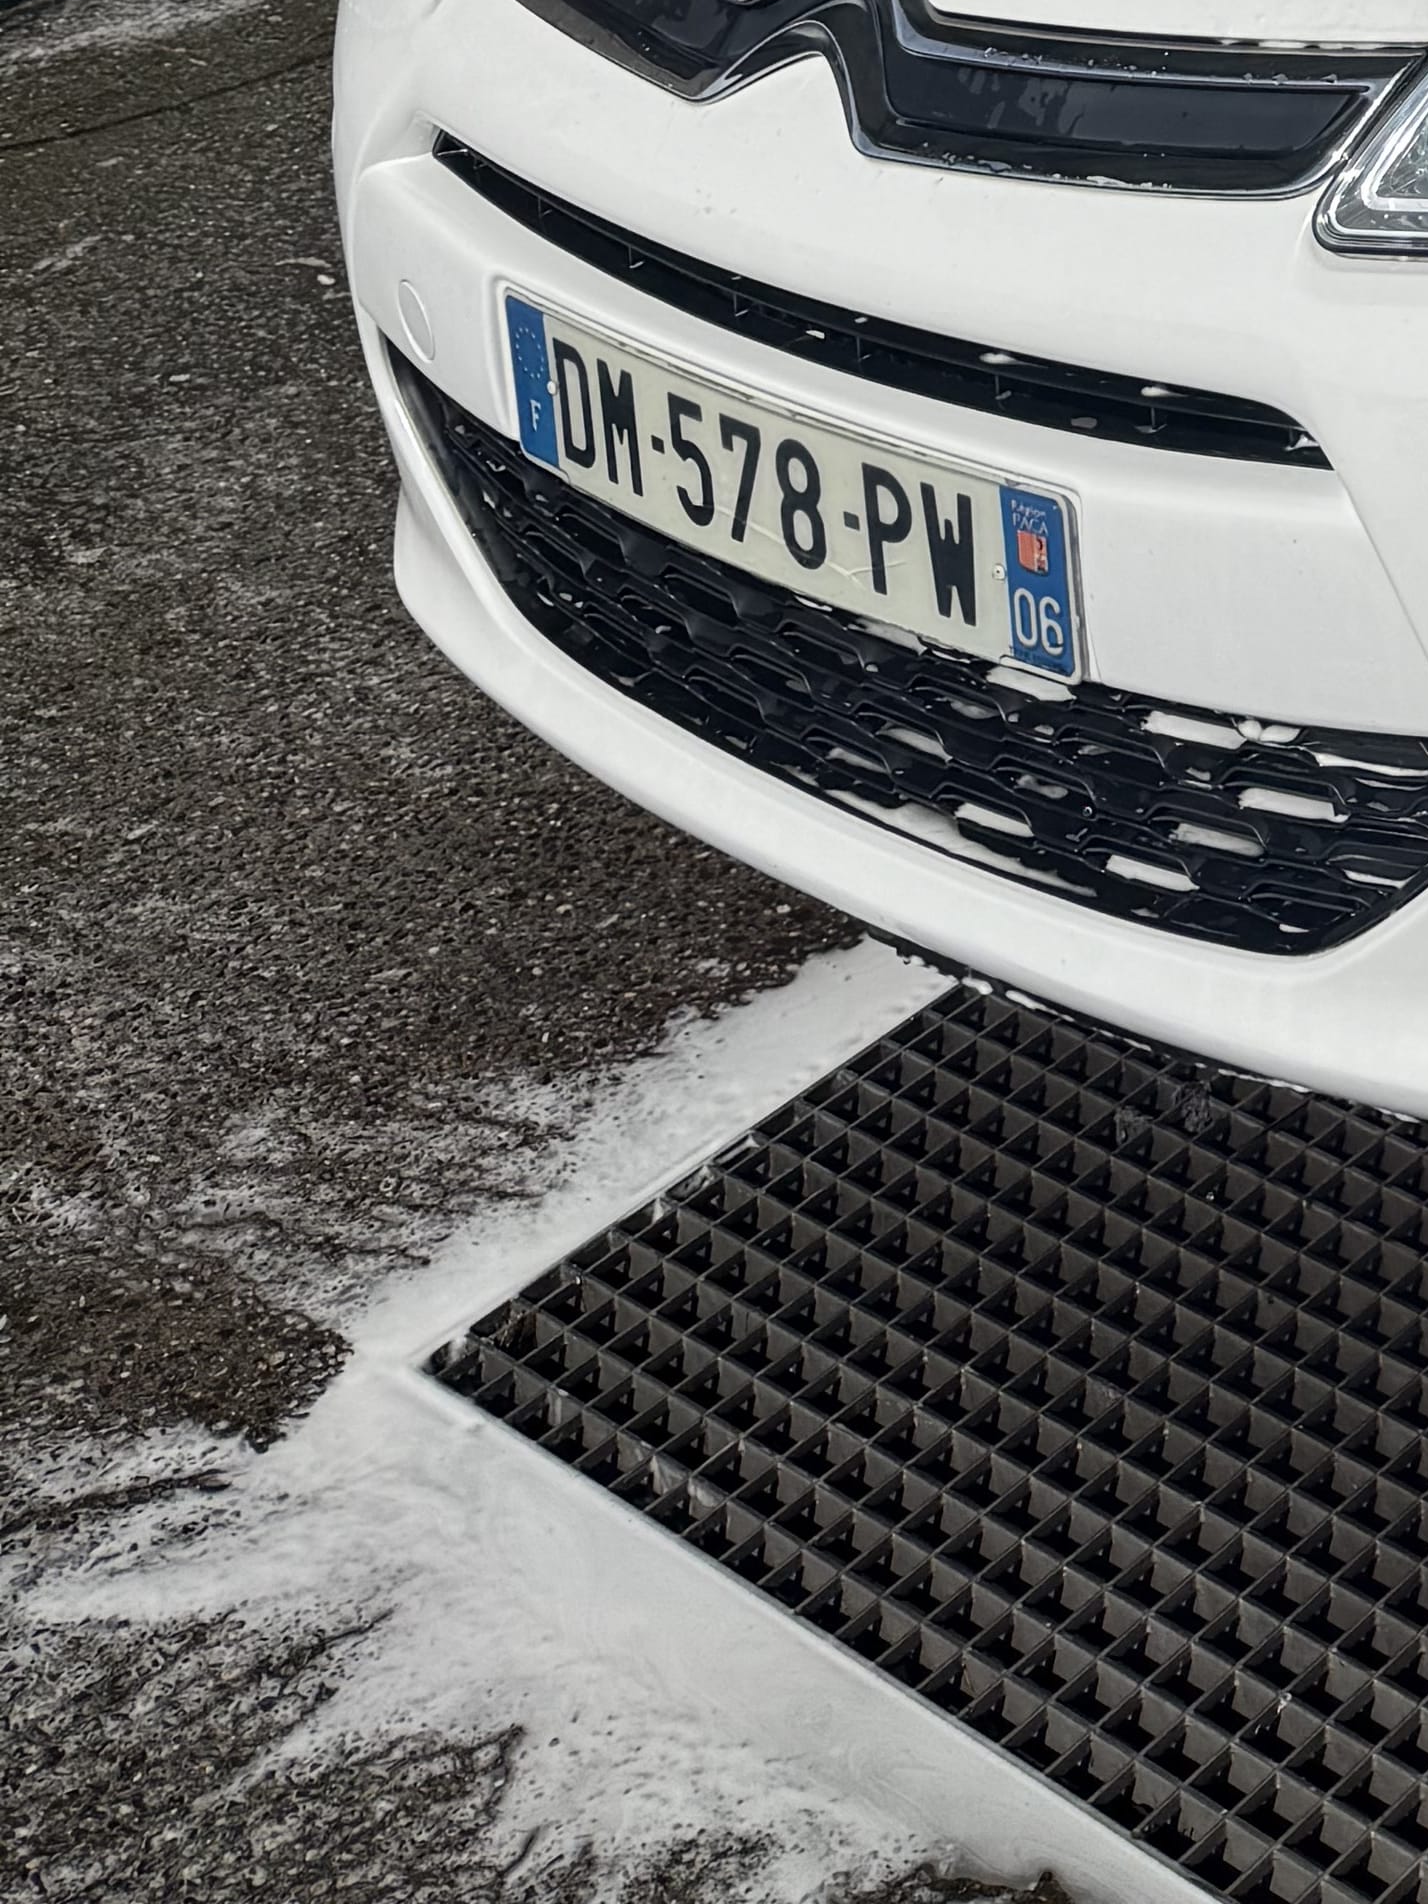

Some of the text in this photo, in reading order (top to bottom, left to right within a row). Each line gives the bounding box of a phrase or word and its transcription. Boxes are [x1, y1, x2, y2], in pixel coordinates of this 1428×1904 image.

[530, 399, 542, 432] F
[552, 337, 978, 628] DM-578-PW
[1012, 512, 1049, 536] PACA
[1013, 587, 1064, 656] 06
